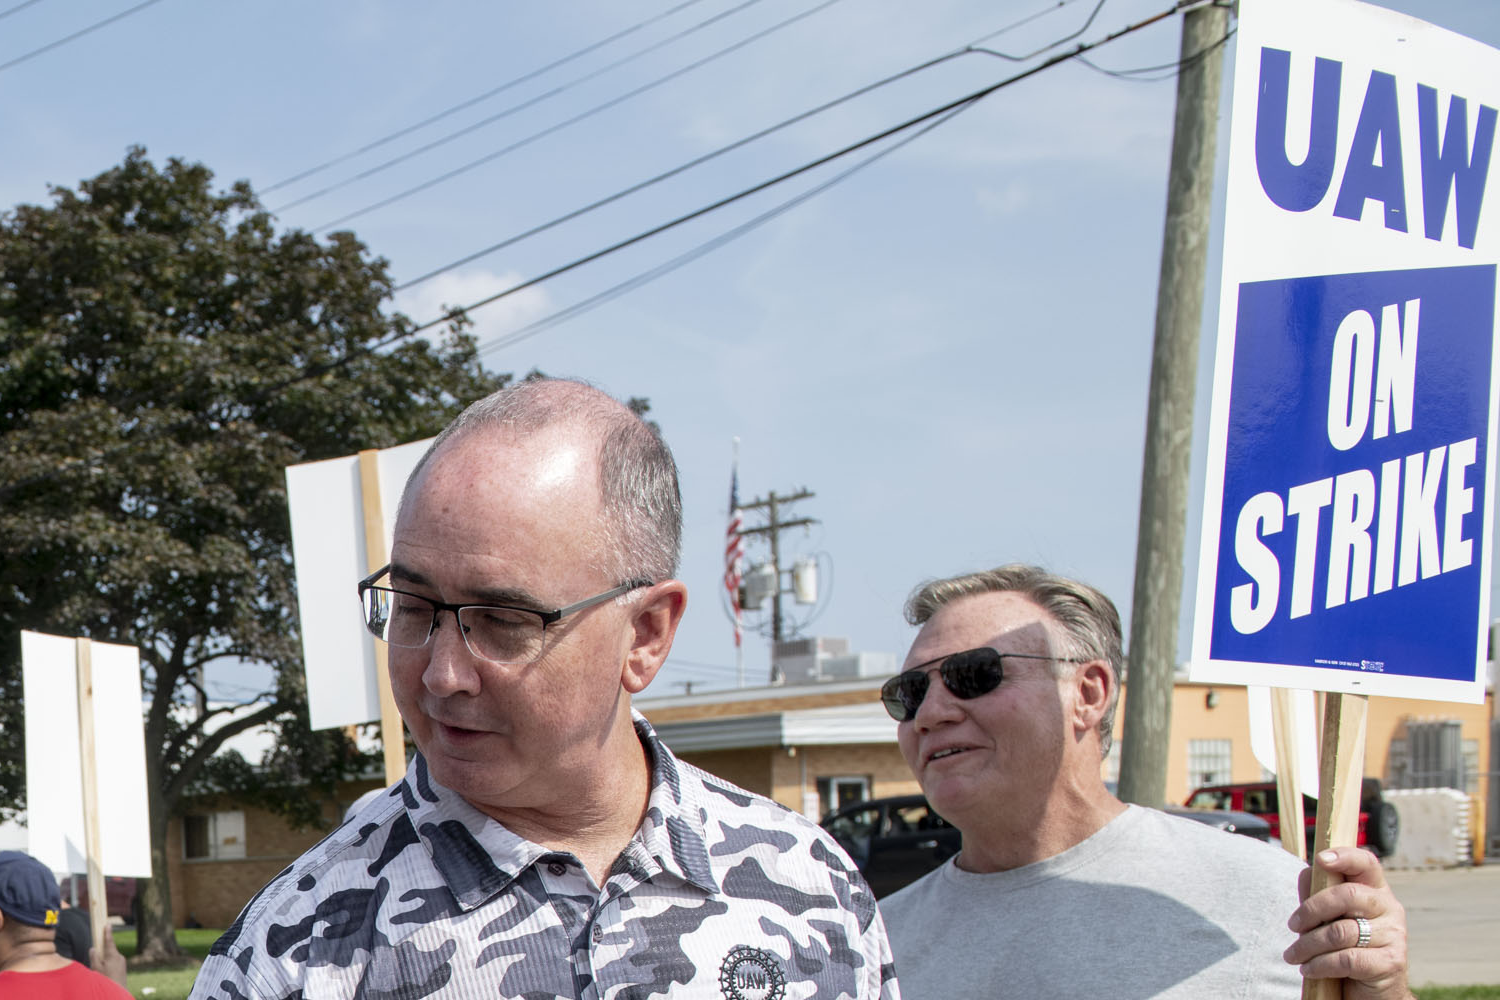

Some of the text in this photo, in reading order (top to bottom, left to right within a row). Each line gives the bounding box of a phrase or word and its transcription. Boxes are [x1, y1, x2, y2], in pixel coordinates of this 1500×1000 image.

[1255, 46, 1499, 250] UAW
[1327, 298, 1421, 452] ON
[1230, 437, 1477, 635] STRIKE
[736, 972, 766, 990] UAW
